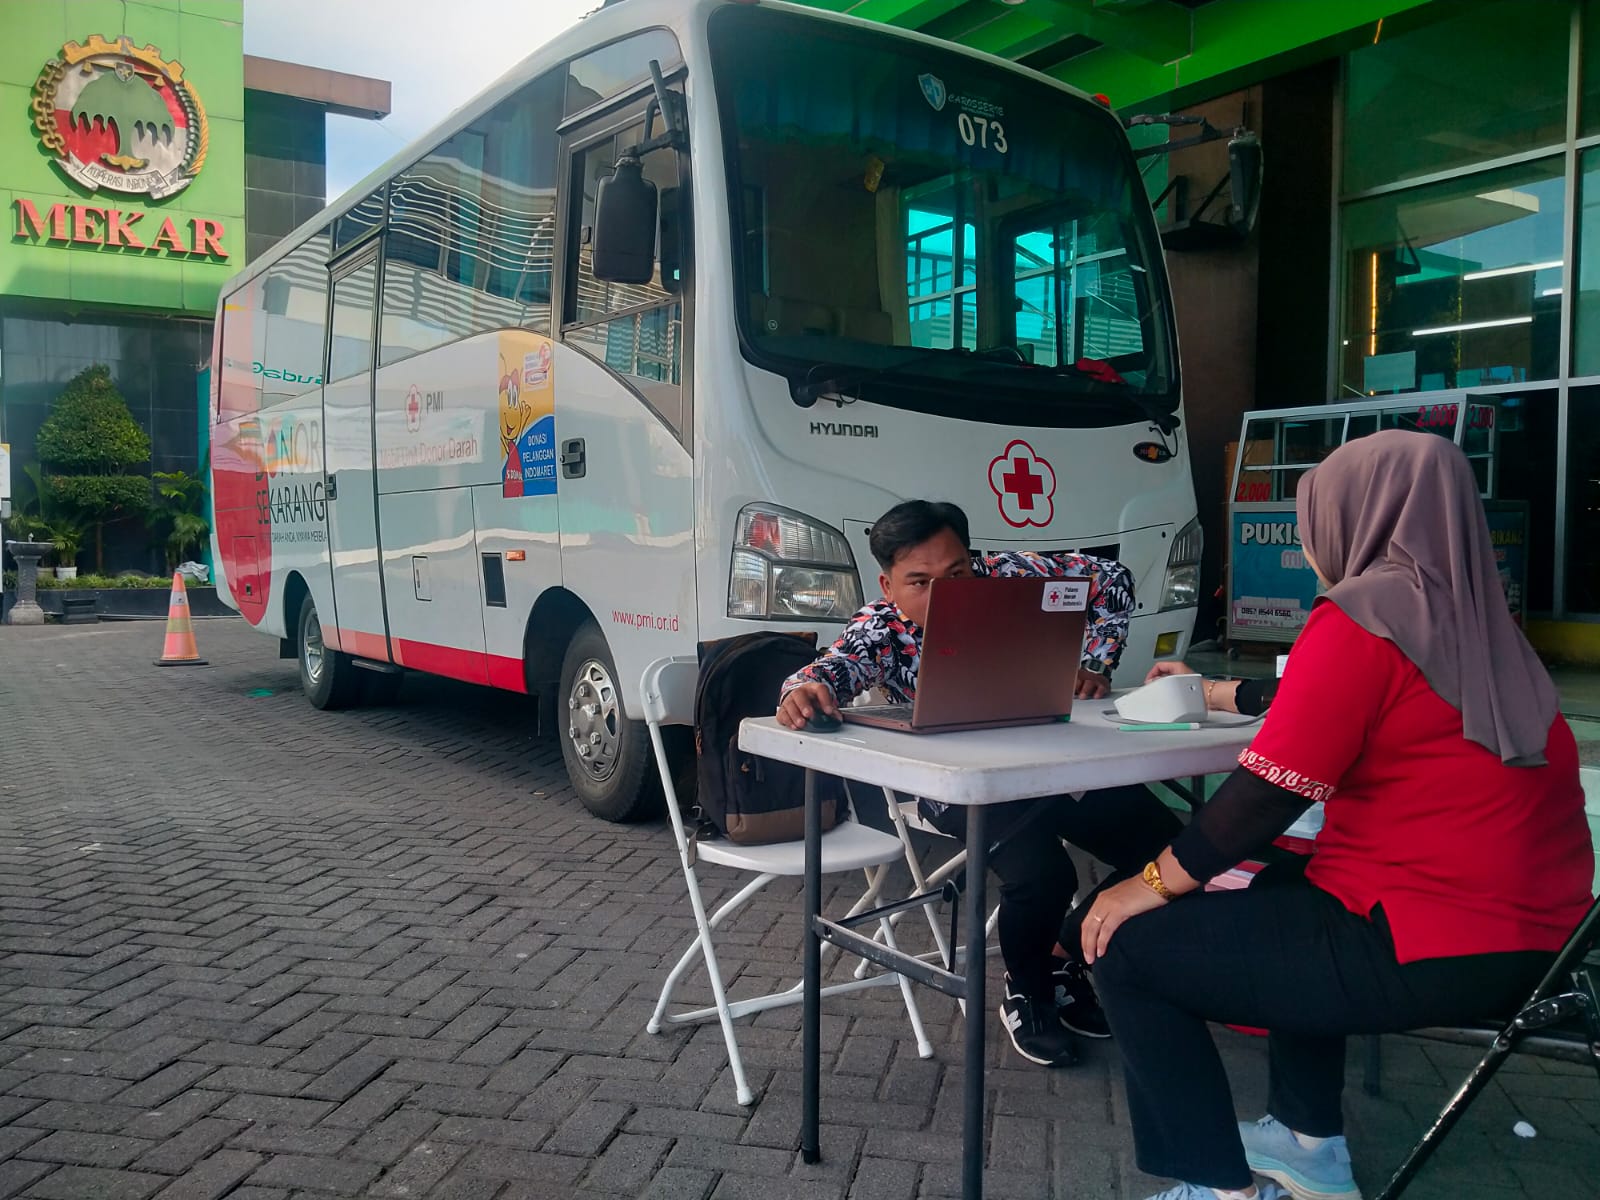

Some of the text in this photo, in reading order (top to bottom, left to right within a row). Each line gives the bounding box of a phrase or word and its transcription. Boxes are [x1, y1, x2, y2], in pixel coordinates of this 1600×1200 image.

[958, 112, 1008, 154] 073
[86, 164, 124, 188] KOPERASI
[14, 198, 229, 258] MEKAR
[426, 391, 444, 415] PMI
[1415, 404, 1459, 428] 2.000
[527, 433, 548, 446] DONASI
[810, 421, 879, 438] HYUNDAI
[421, 442, 447, 462] Donor
[448, 434, 478, 459] Darah
[522, 448, 554, 463] PELANGGAN
[524, 464, 555, 478] INDOMARET
[256, 480, 326, 525] SEKARANG
[1236, 482, 1272, 502] 2.000
[611, 609, 679, 632] www.pmi.or.id
